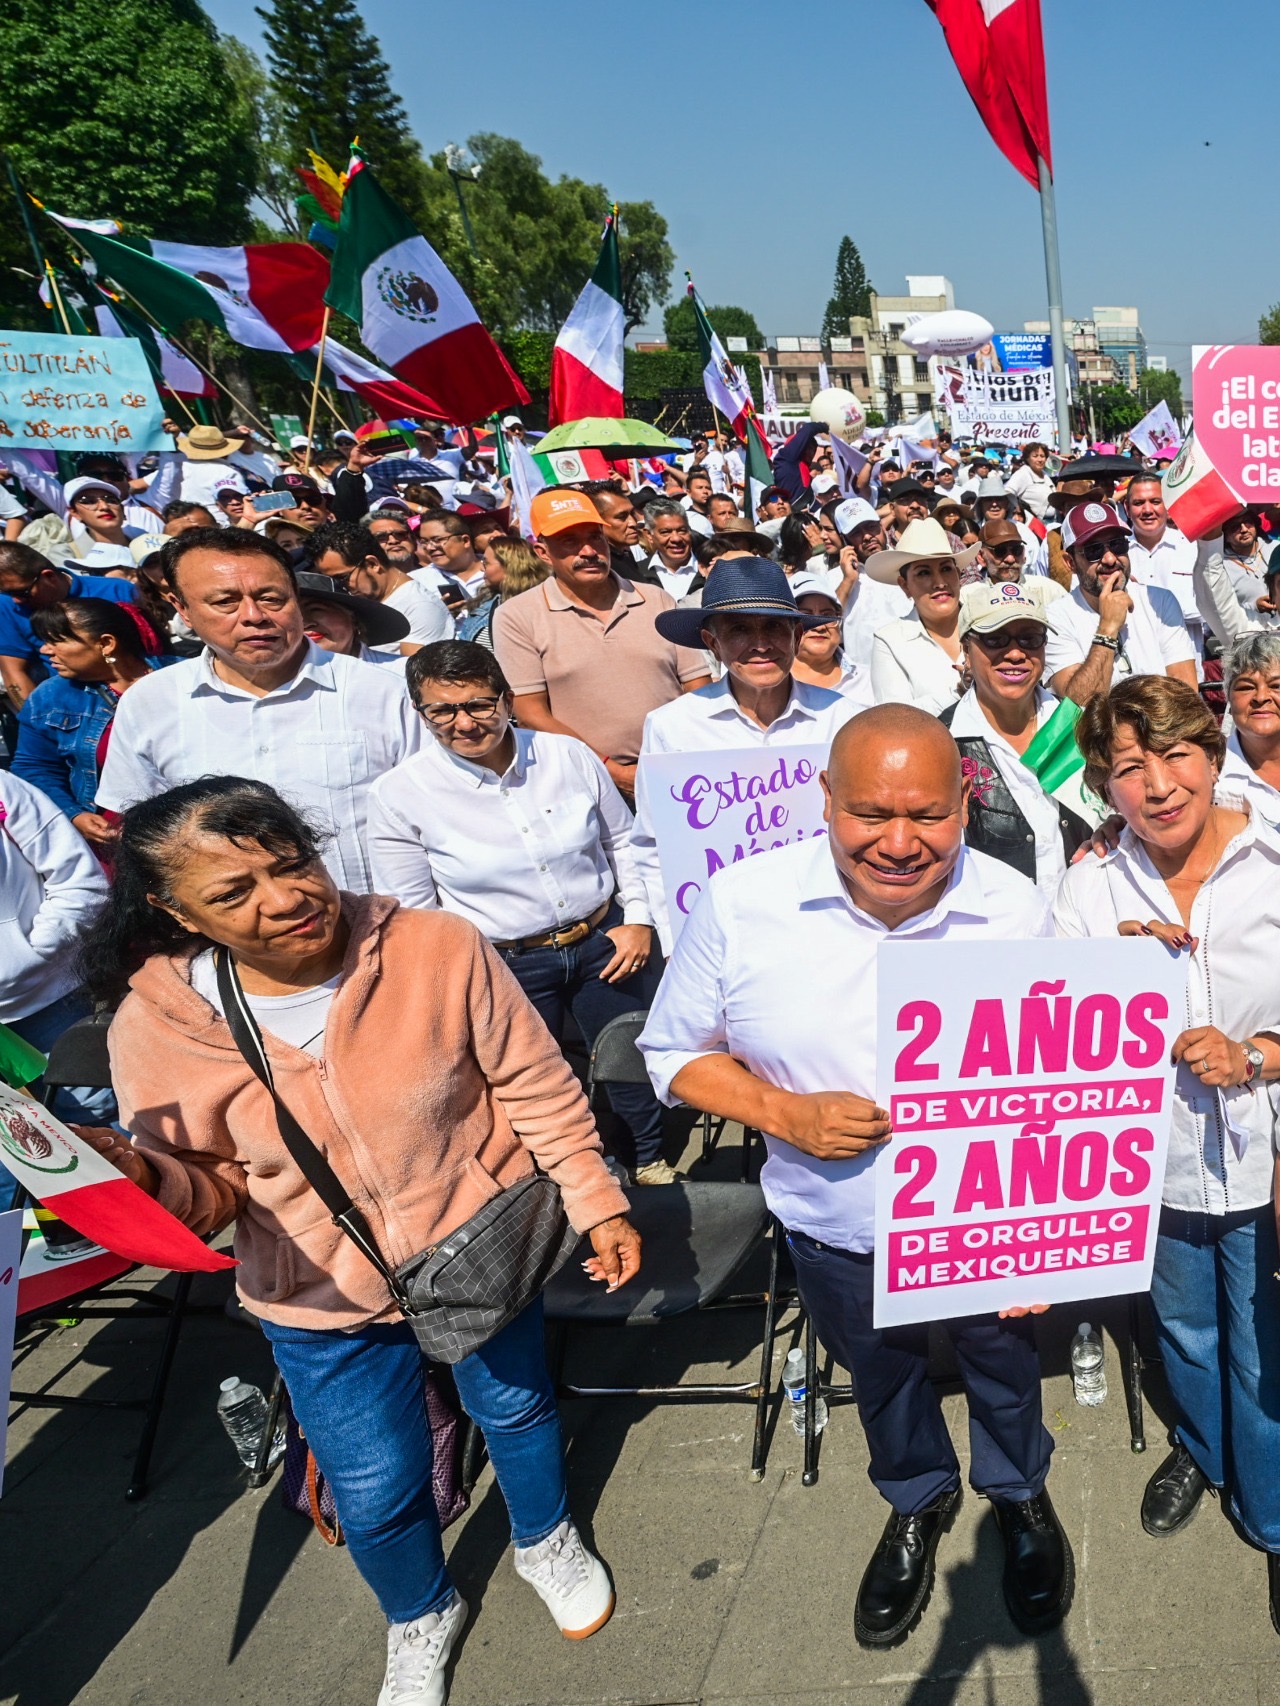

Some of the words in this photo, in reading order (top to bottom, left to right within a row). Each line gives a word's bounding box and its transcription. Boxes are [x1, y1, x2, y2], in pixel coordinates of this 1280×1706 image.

[999, 335, 1046, 343] JORNADAS
[1004, 342, 1043, 351] MÉDICAS
[121, 390, 147, 409] de
[1221, 375, 1255, 406] ¡El
[972, 421, 1041, 440] Presente
[999, 409, 1016, 420] de
[1212, 404, 1256, 429] del
[670, 757, 817, 830] Estado
[745, 801, 790, 836] de
[895, 1001, 941, 1082] 2
[958, 979, 1169, 1079] AÑOS
[896, 1099, 947, 1125] DE
[960, 1086, 1151, 1120] VICTORIA,
[40, 1119, 79, 1154] MEXICO
[892, 1145, 937, 1220] 2
[953, 1120, 1154, 1214] AÑOS
[901, 1232, 949, 1257] DE
[962, 1212, 1133, 1250] ORGULLO
[897, 1240, 1131, 1288] MEXIQUENSE
